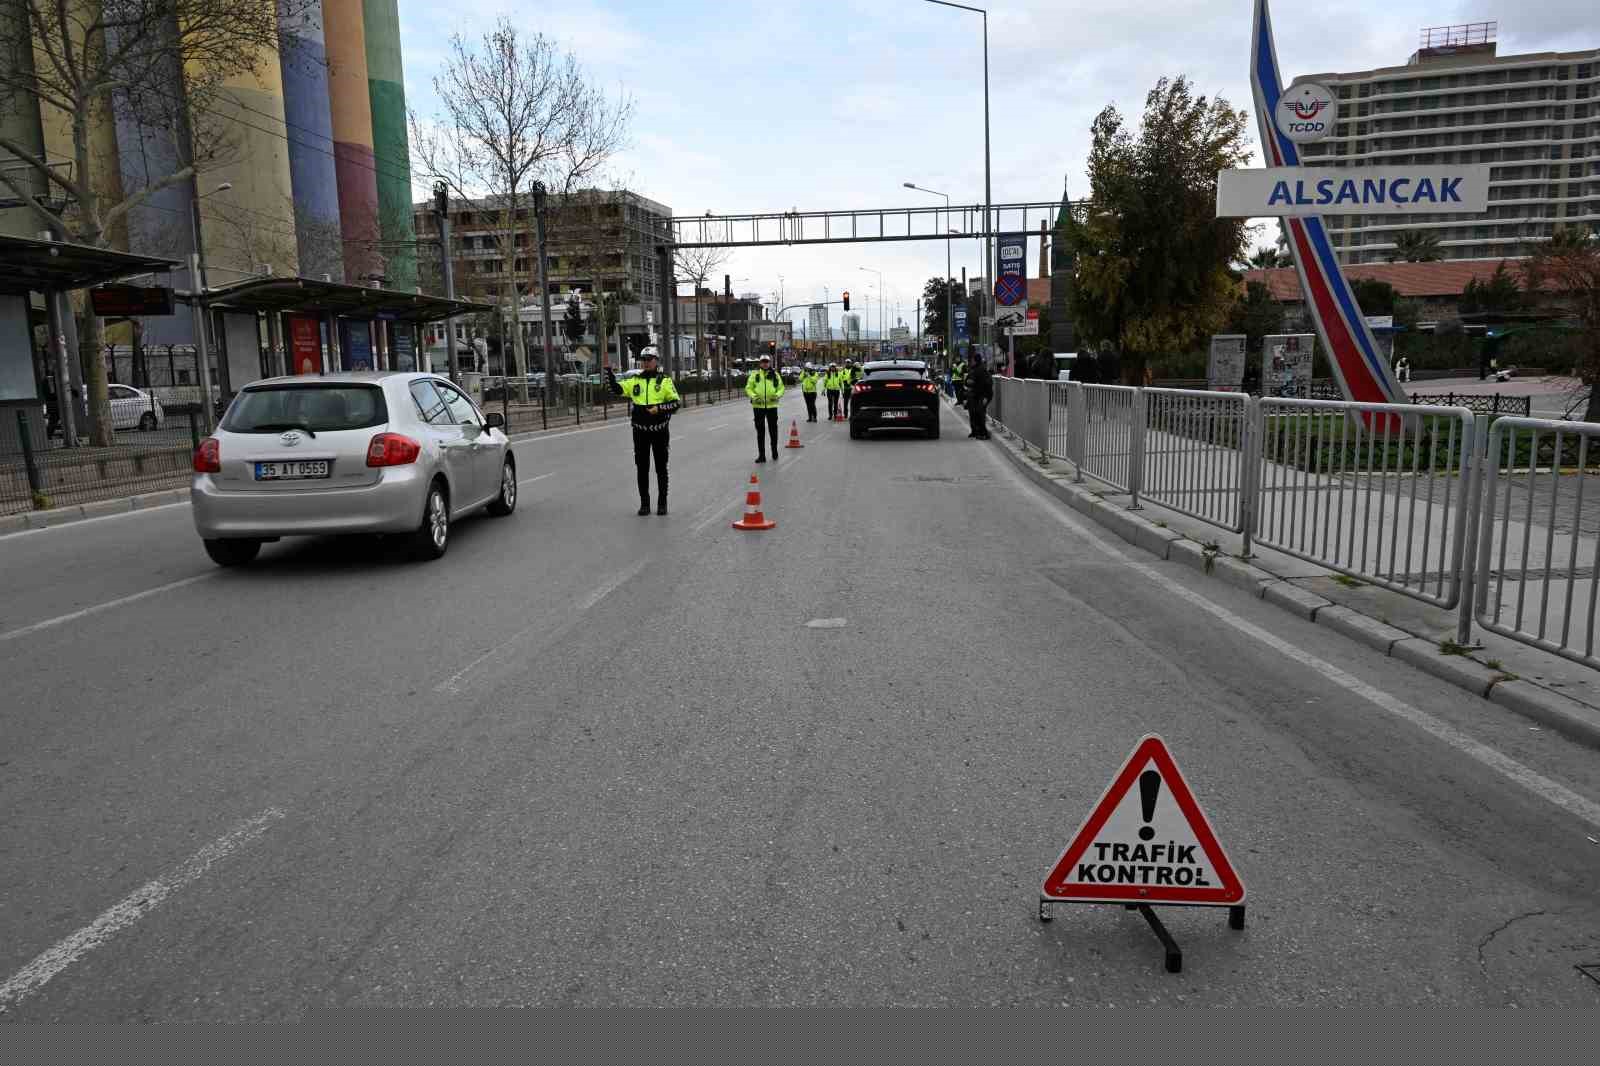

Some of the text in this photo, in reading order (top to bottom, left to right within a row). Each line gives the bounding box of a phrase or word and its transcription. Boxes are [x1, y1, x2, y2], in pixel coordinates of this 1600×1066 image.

[1289, 122, 1325, 132] TCDD
[1268, 177, 1464, 206] ALSANCAK
[262, 462, 326, 476] 35 AT 0569
[1094, 840, 1198, 864] TRAFİK
[1078, 863, 1210, 887] KONTROL
